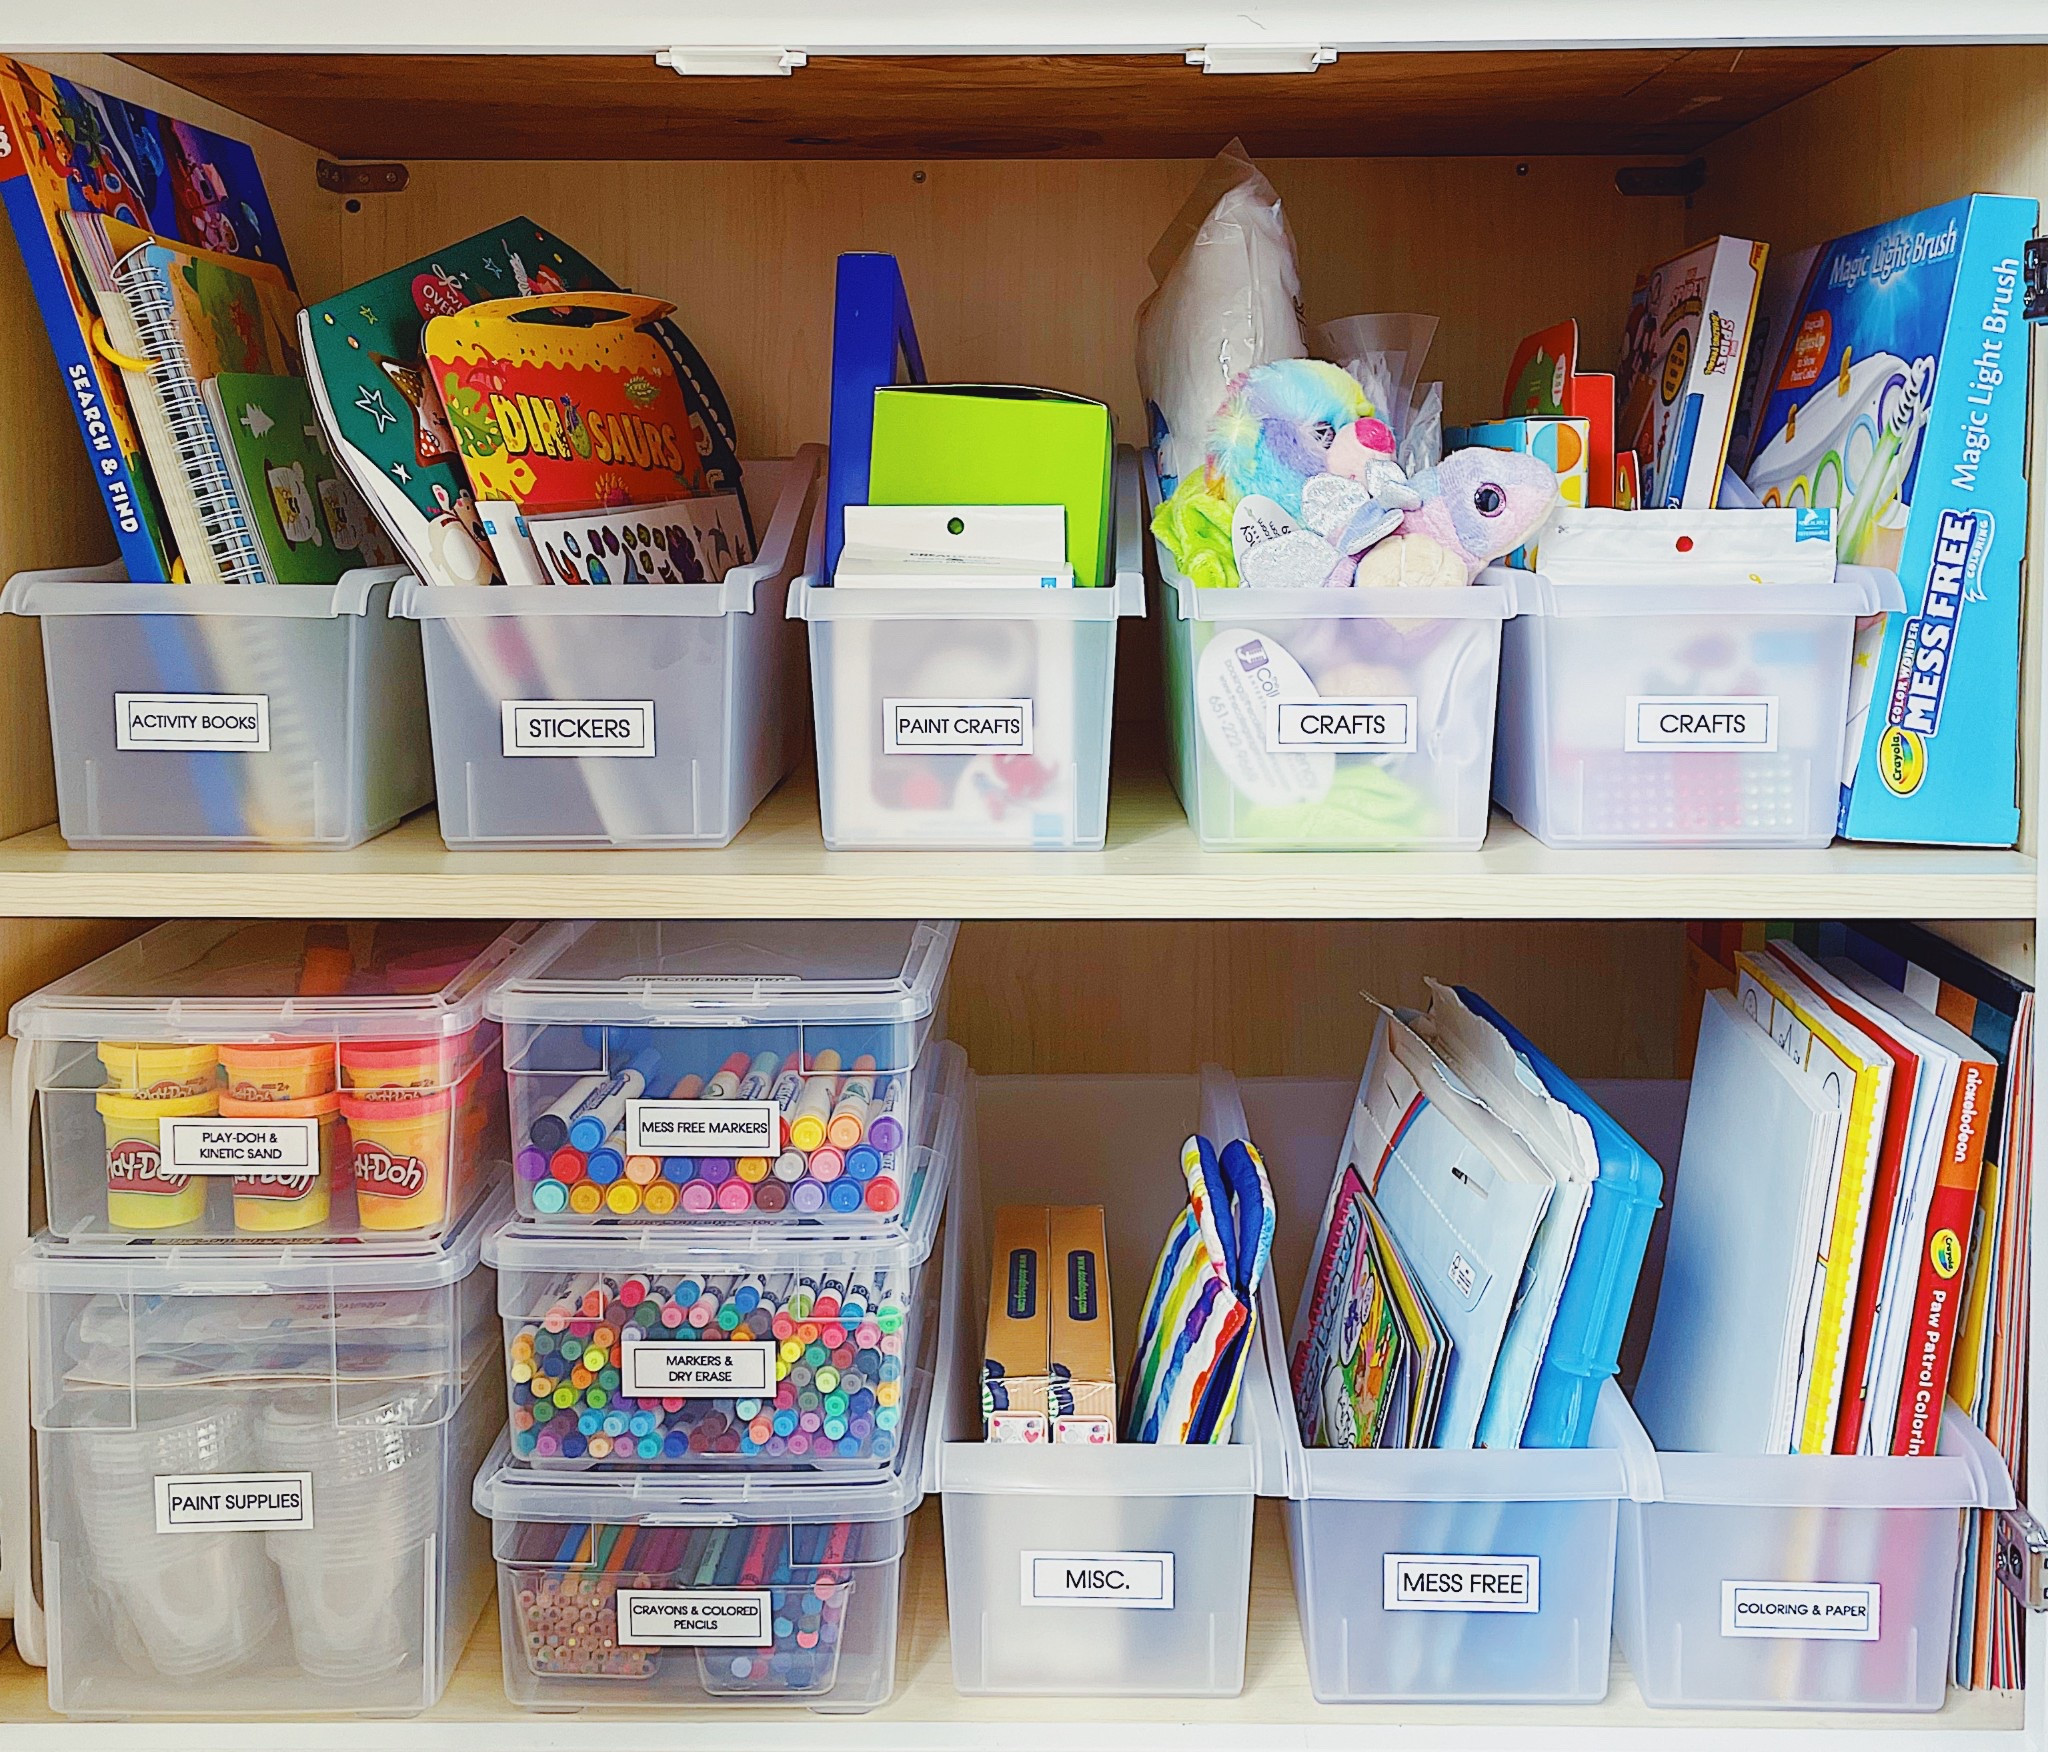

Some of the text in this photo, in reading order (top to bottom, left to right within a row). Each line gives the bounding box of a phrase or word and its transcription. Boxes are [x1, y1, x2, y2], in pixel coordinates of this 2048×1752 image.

[1829, 218, 1957, 288] Magic Light Brush
[1714, 318, 1735, 374] SPIDEY
[1951, 258, 2020, 491] Magic Light Brush
[69, 364, 139, 533] SEARCH & FIND
[1967, 519, 1989, 579] COLORING
[1903, 515, 1976, 734] MESS FREE
[1891, 622, 1920, 724] COLOR WONDER
[131, 714, 257, 730] ACTIVITY BOOKS
[529, 718, 630, 738] STICKERS
[899, 718, 1020, 734] PAINT CRAFTS
[1300, 714, 1384, 734] CRAFTS
[1660, 714, 1745, 734] CRAFTS
[1893, 735, 1901, 781] Crayola
[1954, 1067, 1982, 1163] nickelodeon
[202, 1132, 277, 1143] PLAY-DOH &
[642, 1121, 767, 1134] MESS FREE MARKERS
[200, 1148, 282, 1159] KINETIC SAND
[1945, 1237, 1954, 1269] Crayola
[666, 1355, 733, 1366] MARKERS &
[668, 1370, 732, 1382] DRY ERASE
[1904, 1289, 1947, 1457] Paw Patrol Colorin
[172, 1493, 300, 1511] PAINT SUPPLIES
[1066, 1569, 1130, 1589] MISC.
[1403, 1572, 1523, 1594] MESS FREE
[633, 1604, 758, 1616] CRAYONS & COLORED
[1737, 1602, 1866, 1617] COLORING & PAPER
[673, 1619, 718, 1630] PENCILS
